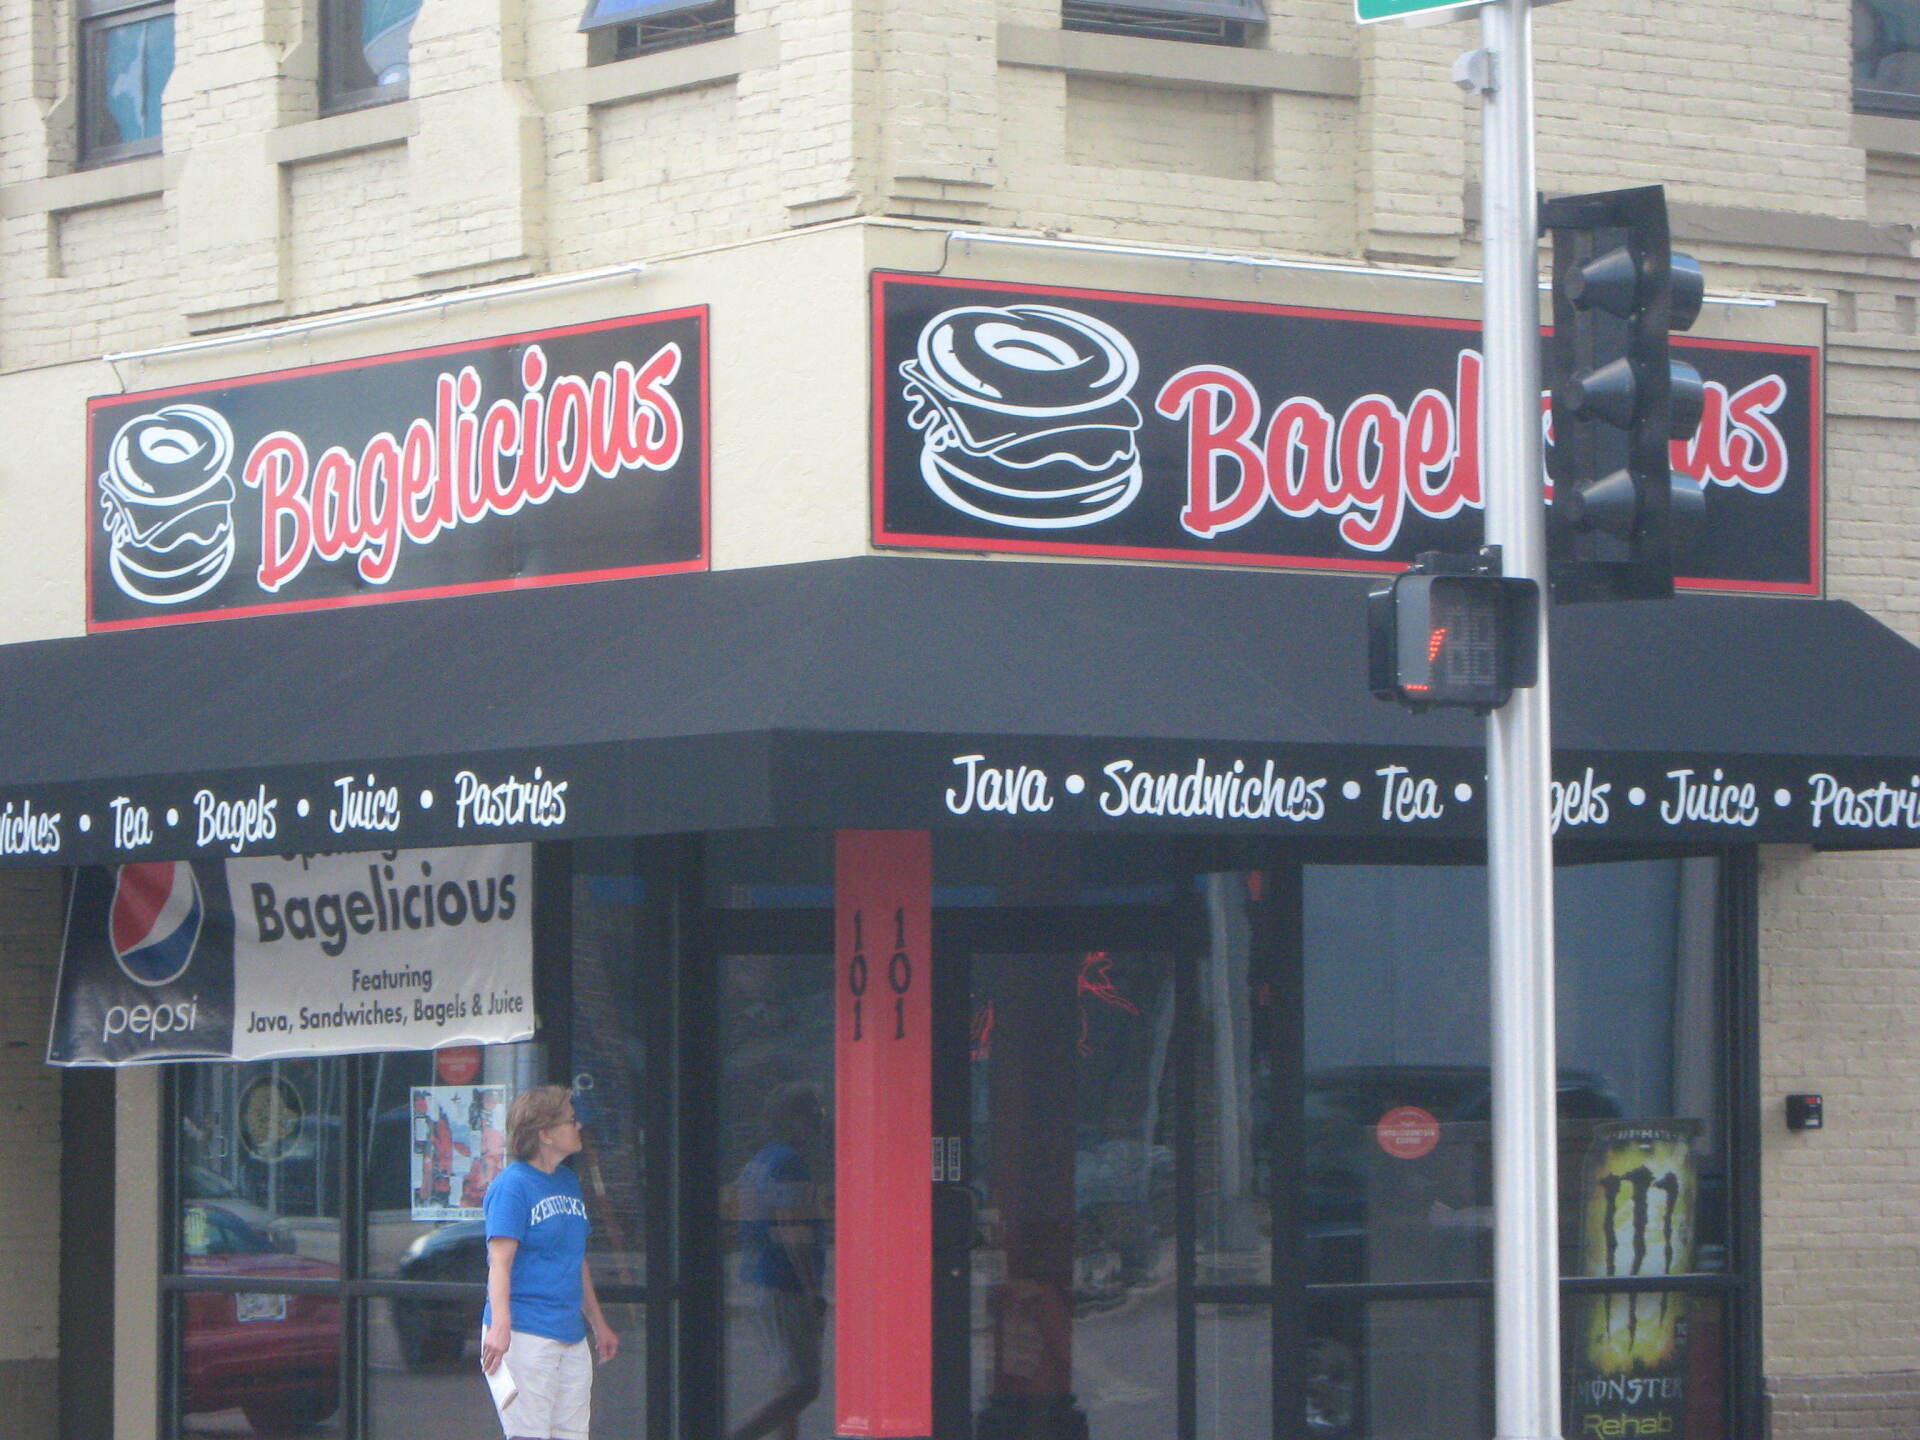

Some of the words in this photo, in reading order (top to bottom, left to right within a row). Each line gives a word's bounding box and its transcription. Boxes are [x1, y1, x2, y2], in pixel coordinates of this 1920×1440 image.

[243, 343, 683, 592] Bagelicious
[1156, 349, 1788, 552] Bagelus
[110, 796, 153, 849] Tea
[194, 784, 277, 854] Bagels
[329, 773, 400, 833] Juice
[455, 766, 569, 828] Pastries
[946, 754, 1054, 815] Java
[1100, 758, 1328, 822] Sandwiches
[1376, 764, 1444, 823] Tea
[1660, 768, 1758, 828] Juice
[1807, 773, 1920, 829] Pastri
[251, 860, 516, 957] Bagelicious
[352, 964, 433, 992] Featuring
[103, 994, 198, 1043] pepsi
[247, 1010, 293, 1034] Java,
[299, 1002, 408, 1030] Sandwiches,
[414, 993, 466, 1026] Bagels
[471, 993, 483, 1016] &
[488, 990, 524, 1015] Juice
[530, 1195, 588, 1226] KENTUCKY
[1583, 1411, 1673, 1440] Rehab
